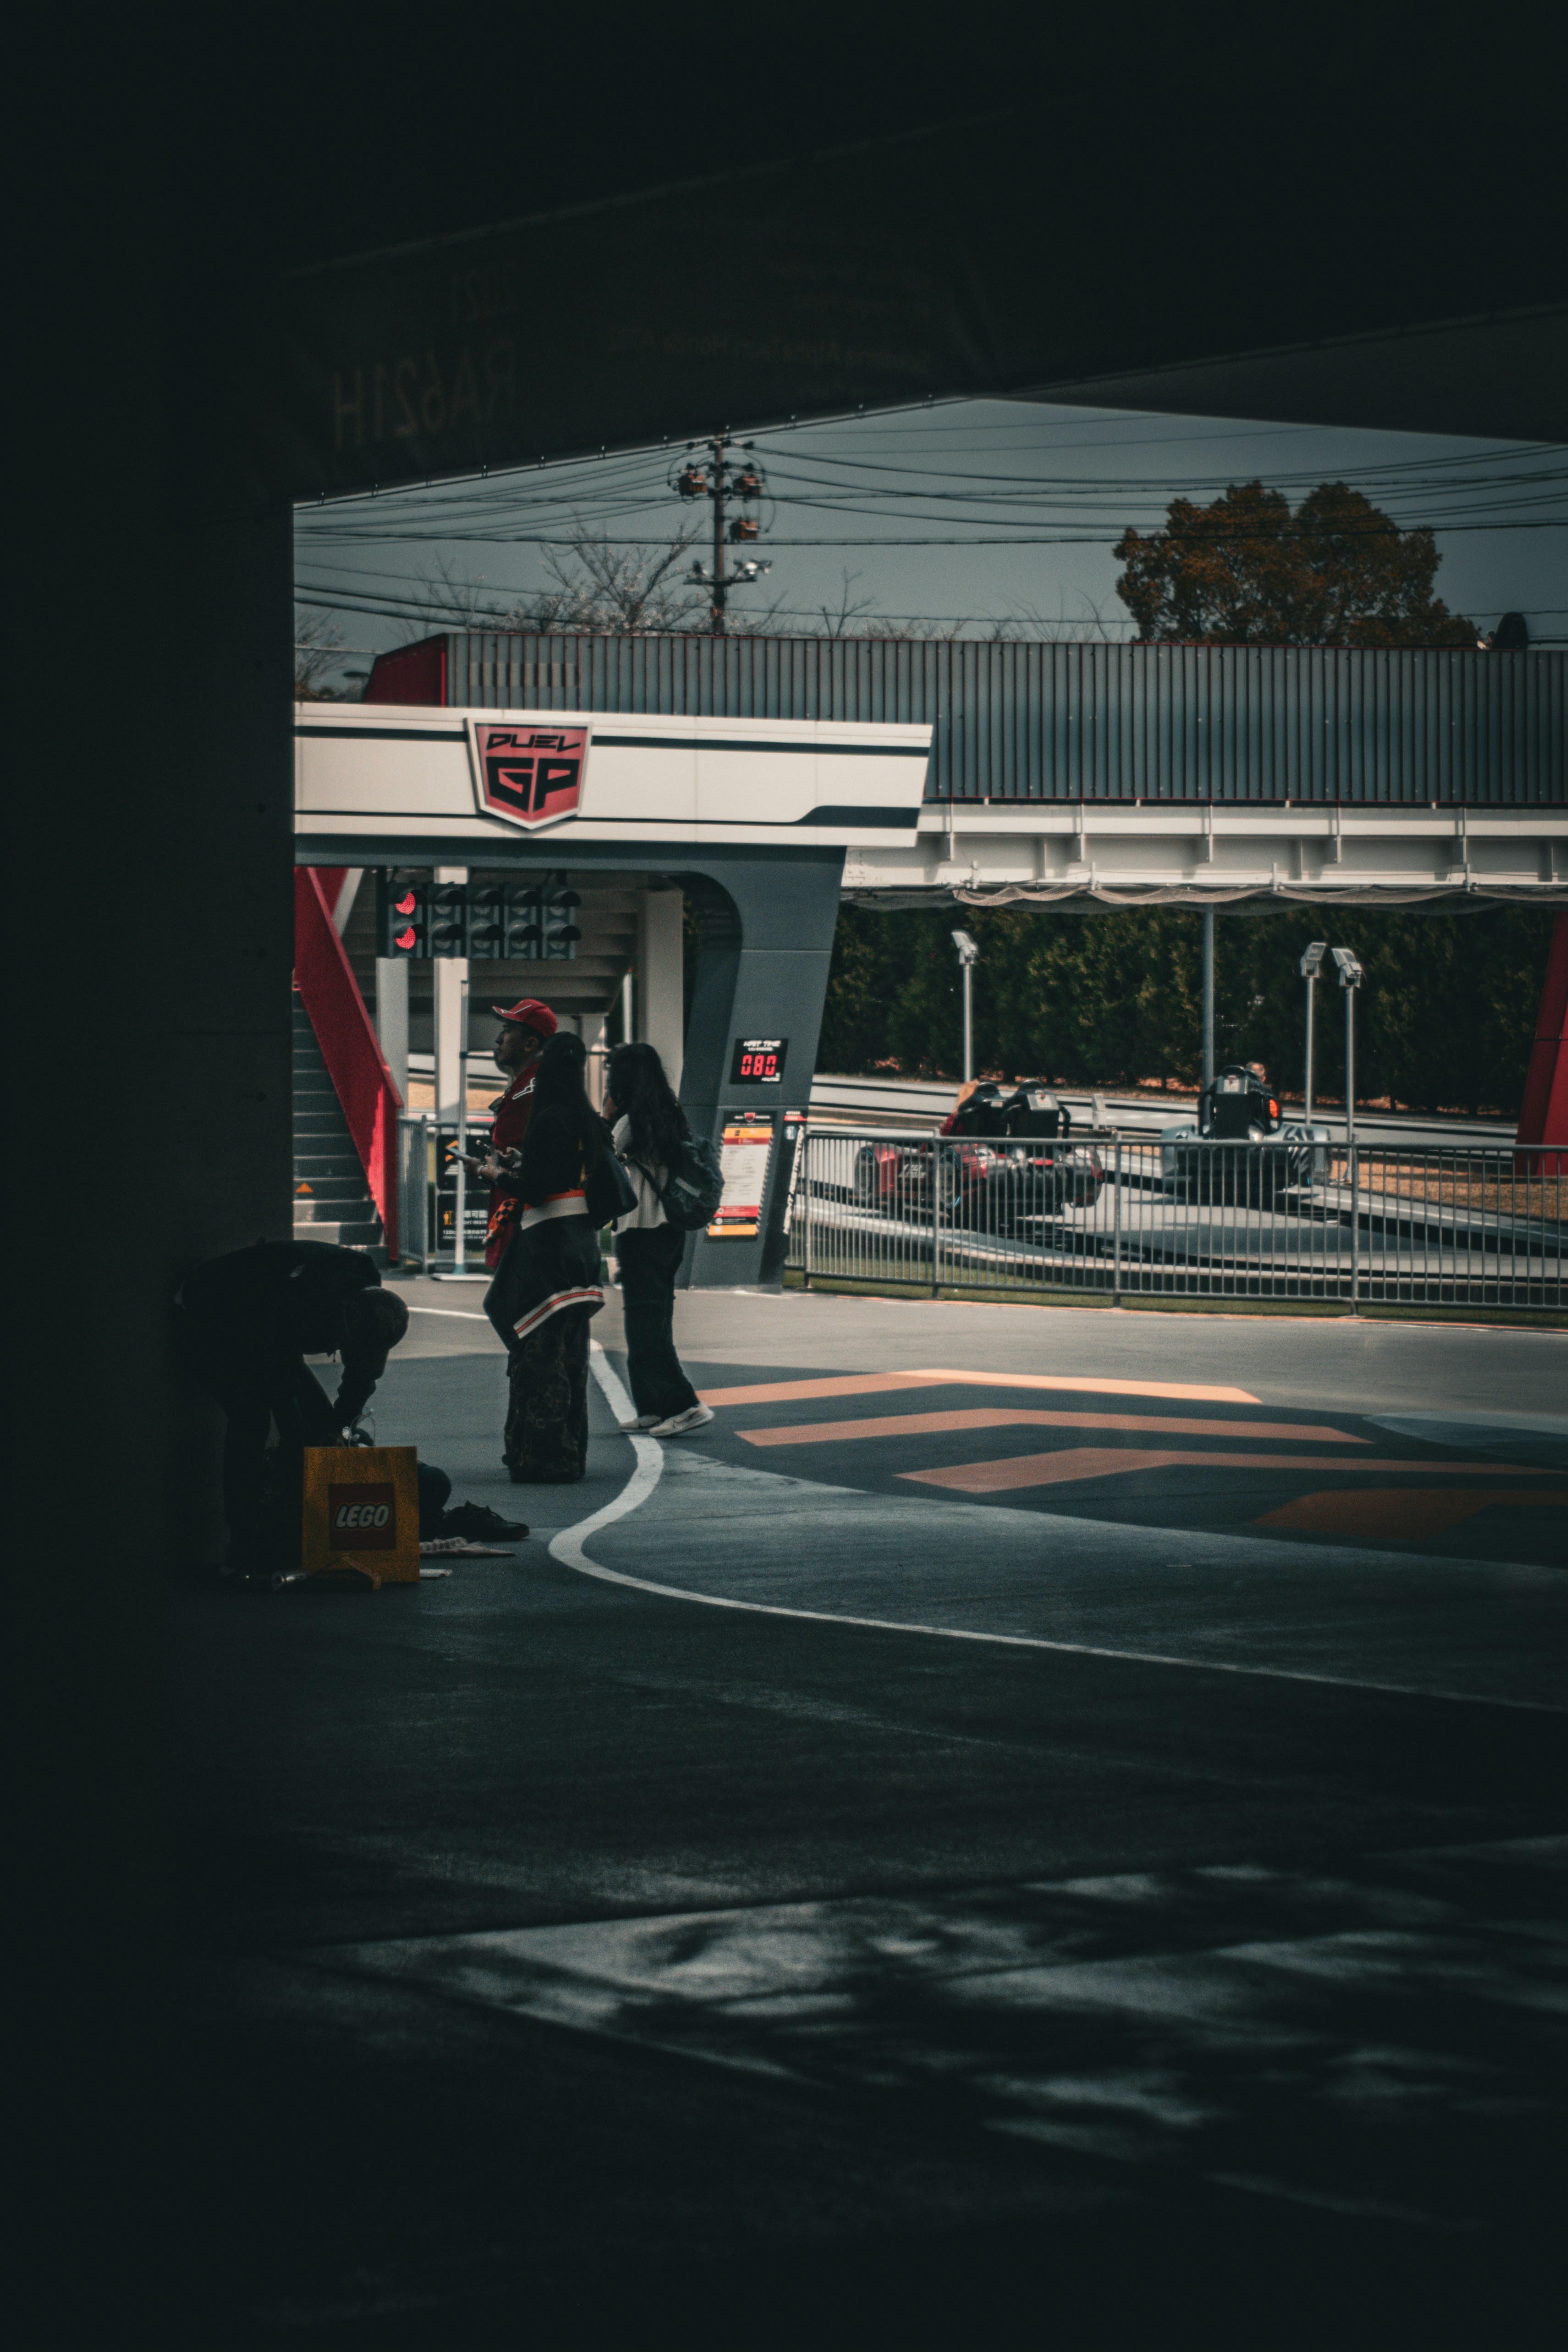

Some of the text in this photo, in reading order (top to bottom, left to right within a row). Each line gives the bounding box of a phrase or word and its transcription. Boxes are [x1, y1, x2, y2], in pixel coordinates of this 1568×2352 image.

[486, 734, 580, 752] DUEL
[486, 756, 580, 813] GP
[740, 1055, 777, 1076] 080
[336, 1504, 389, 1528] LEGO
